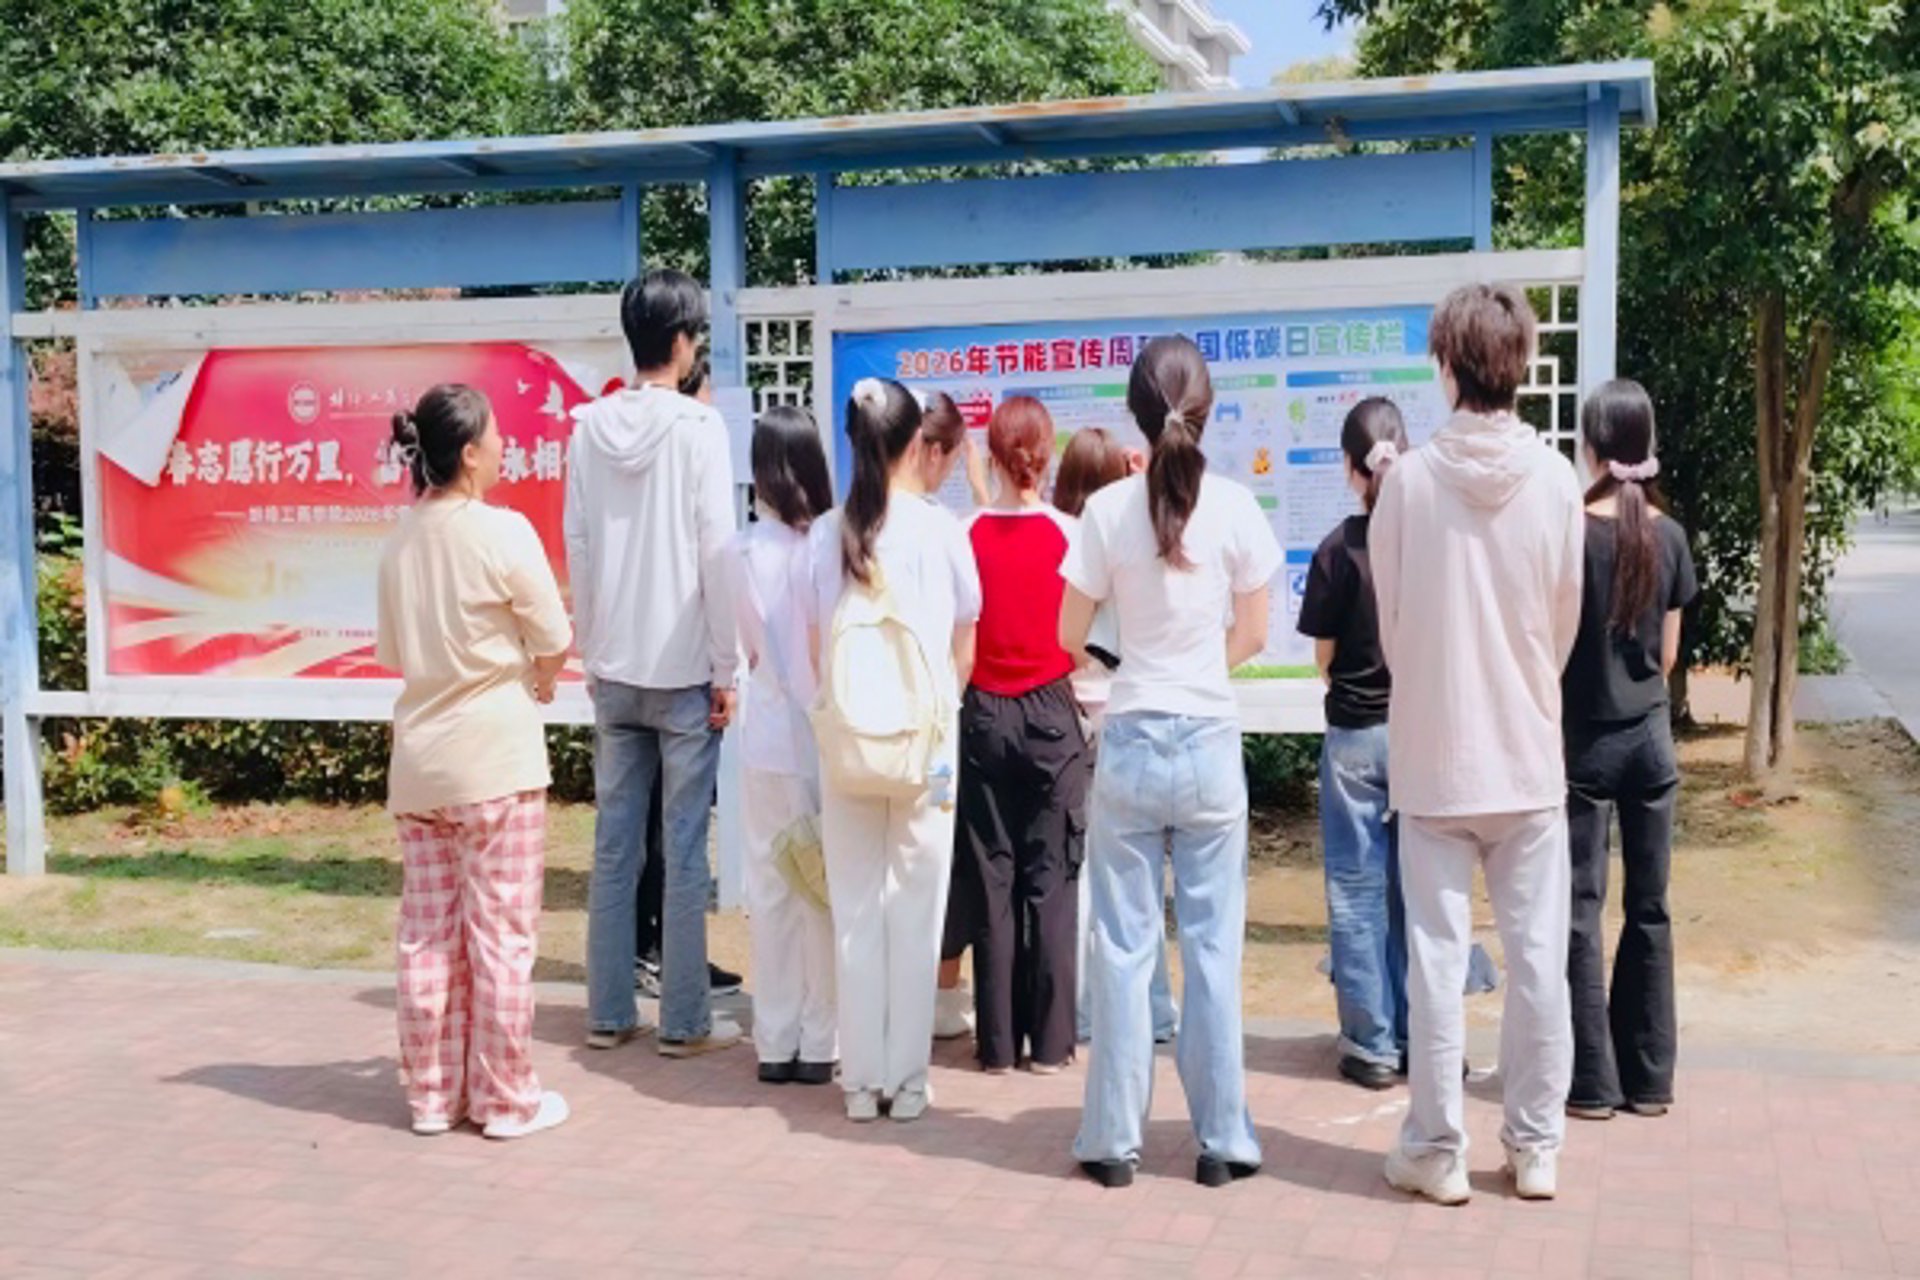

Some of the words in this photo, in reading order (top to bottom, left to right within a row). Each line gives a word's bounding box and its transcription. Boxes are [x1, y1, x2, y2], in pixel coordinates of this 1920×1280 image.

[896, 320, 1400, 377] 2026年节能宣传周国低碳日宣传栏
